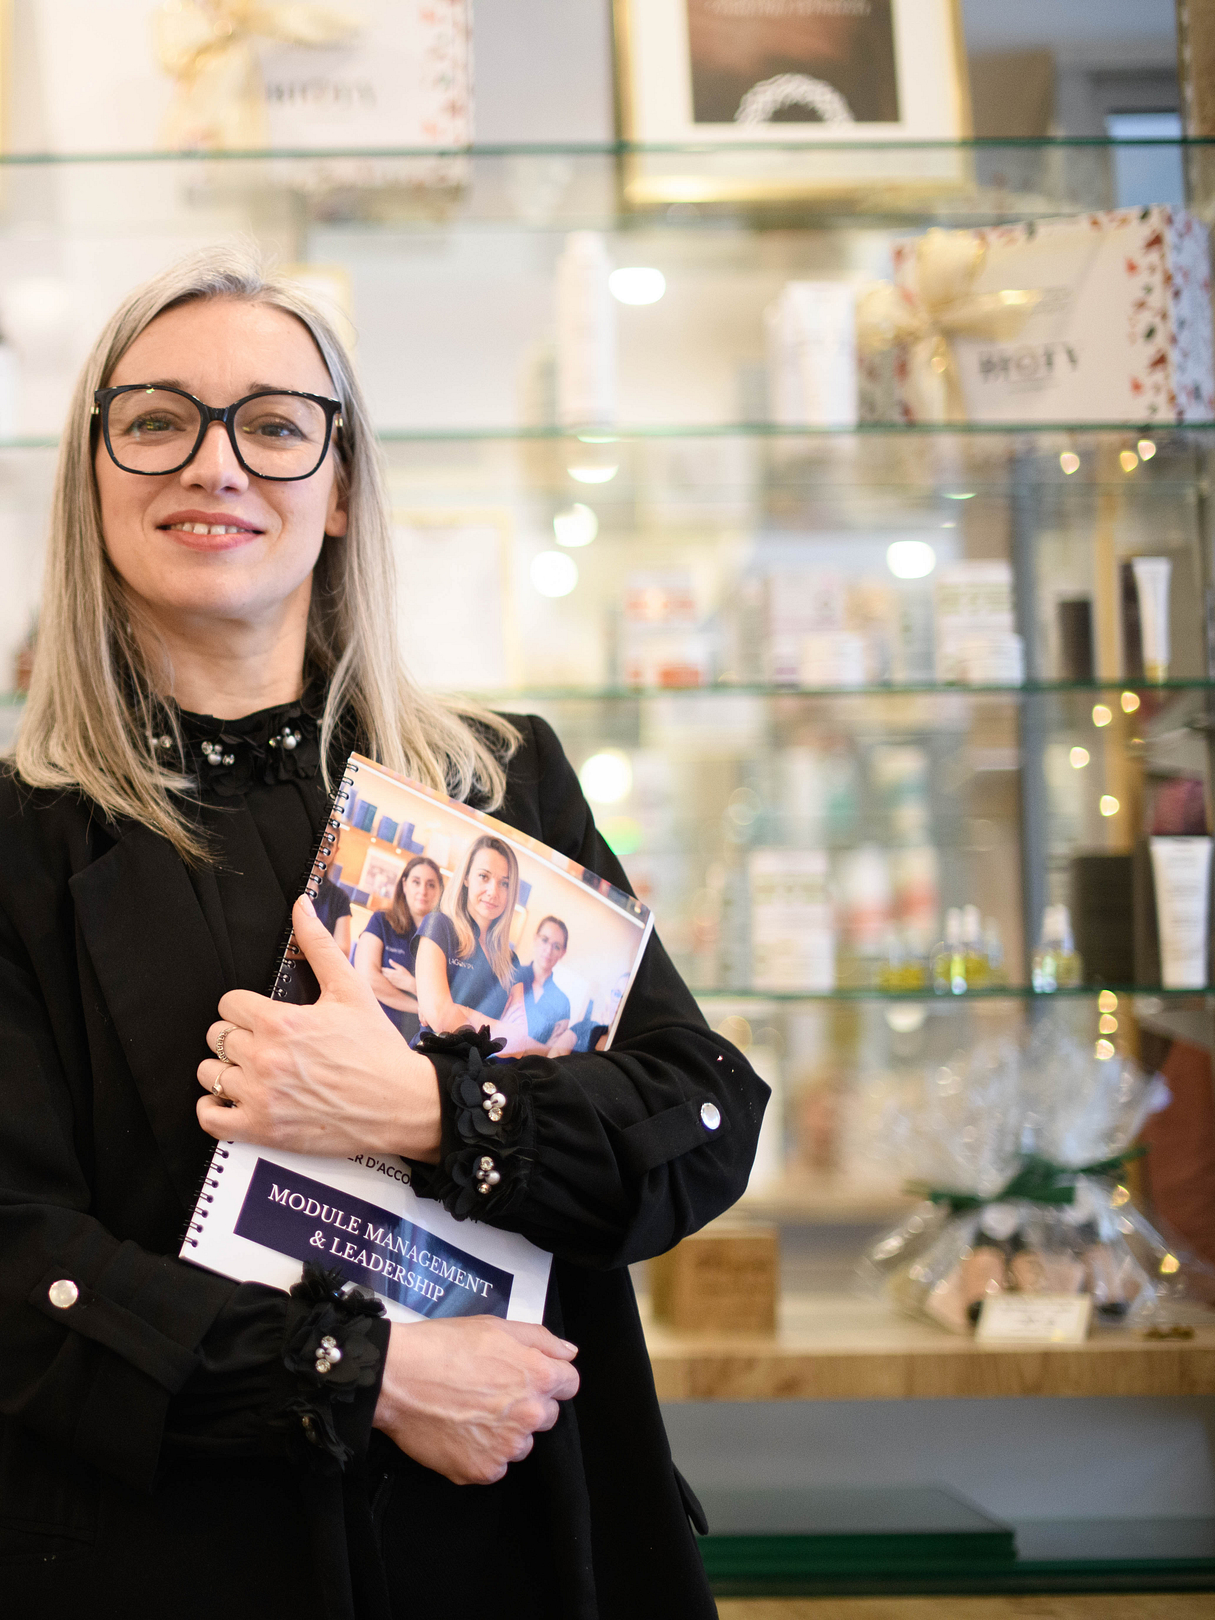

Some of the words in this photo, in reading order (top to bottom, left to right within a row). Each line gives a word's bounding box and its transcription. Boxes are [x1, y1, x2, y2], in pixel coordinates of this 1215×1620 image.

[365, 1156, 412, 1187] D'ACCO
[267, 1183, 362, 1235] MODULE
[362, 1222, 494, 1298] MANAGEMENT
[309, 1230, 327, 1249] &
[328, 1236, 445, 1303] LEADERSHIP
